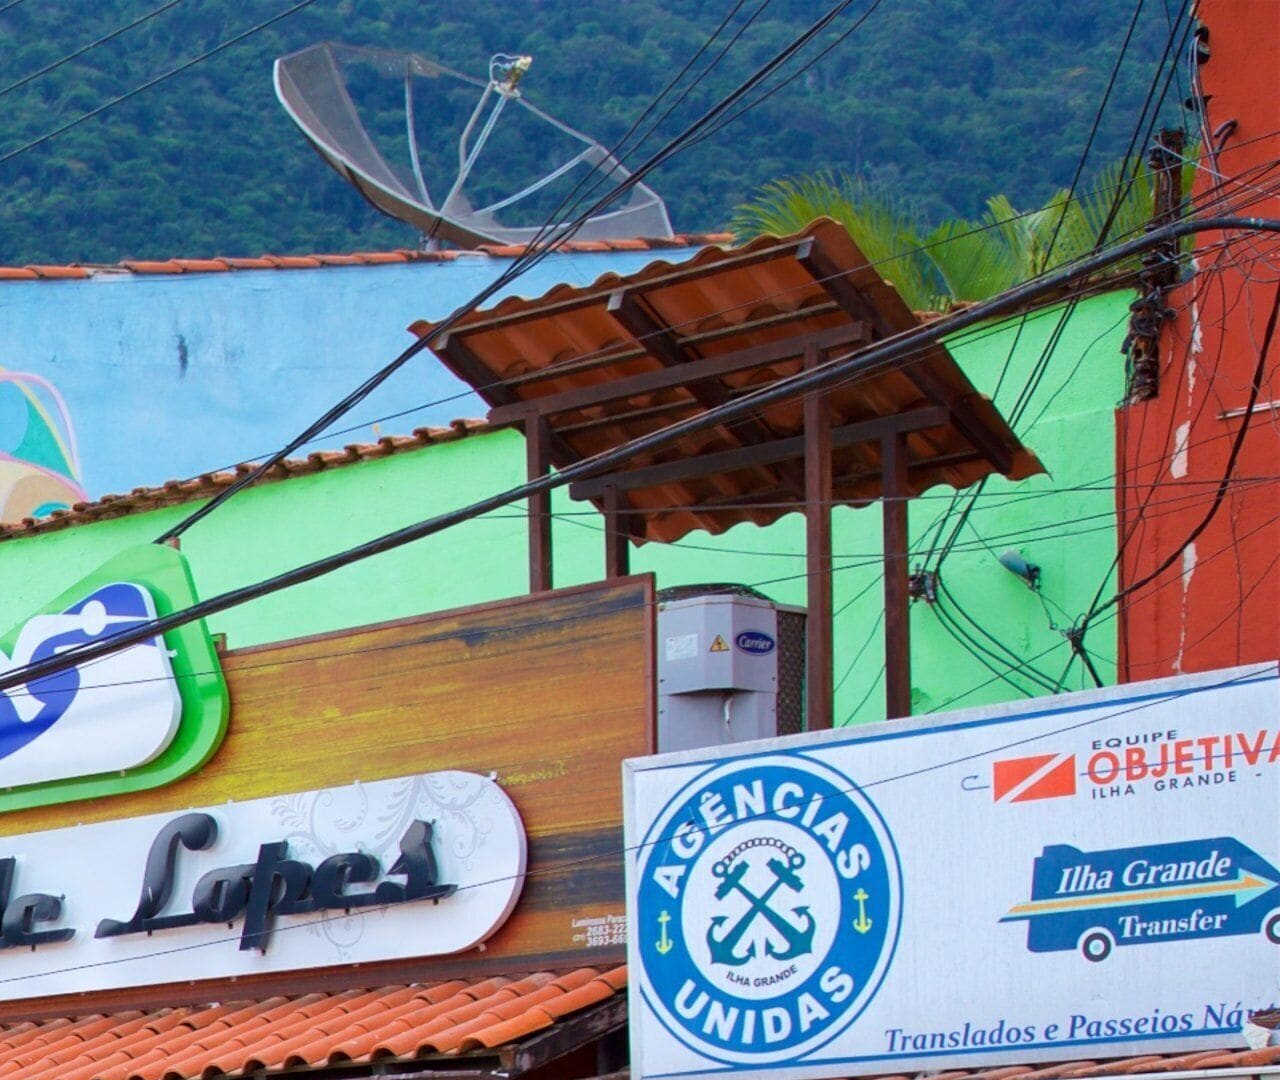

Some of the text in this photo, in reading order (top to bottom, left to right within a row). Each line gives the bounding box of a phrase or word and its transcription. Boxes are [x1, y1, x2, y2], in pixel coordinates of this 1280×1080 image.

[738, 635, 771, 649] Carrier
[1092, 729, 1178, 750] EQUIPE
[1092, 770, 1237, 799] ILHA GRANDE
[653, 779, 871, 900] AGÊNCIAS
[94, 811, 458, 953] Lopes
[1056, 849, 1232, 895] Ilha Grande
[1118, 909, 1228, 939] Transfer
[726, 964, 798, 988] ILHA GRANDE
[673, 966, 855, 1044] UNIDAS
[885, 1018, 1036, 1052] Translados
[1043, 1023, 1059, 1040] e
[1068, 1008, 1193, 1039] Passeios
